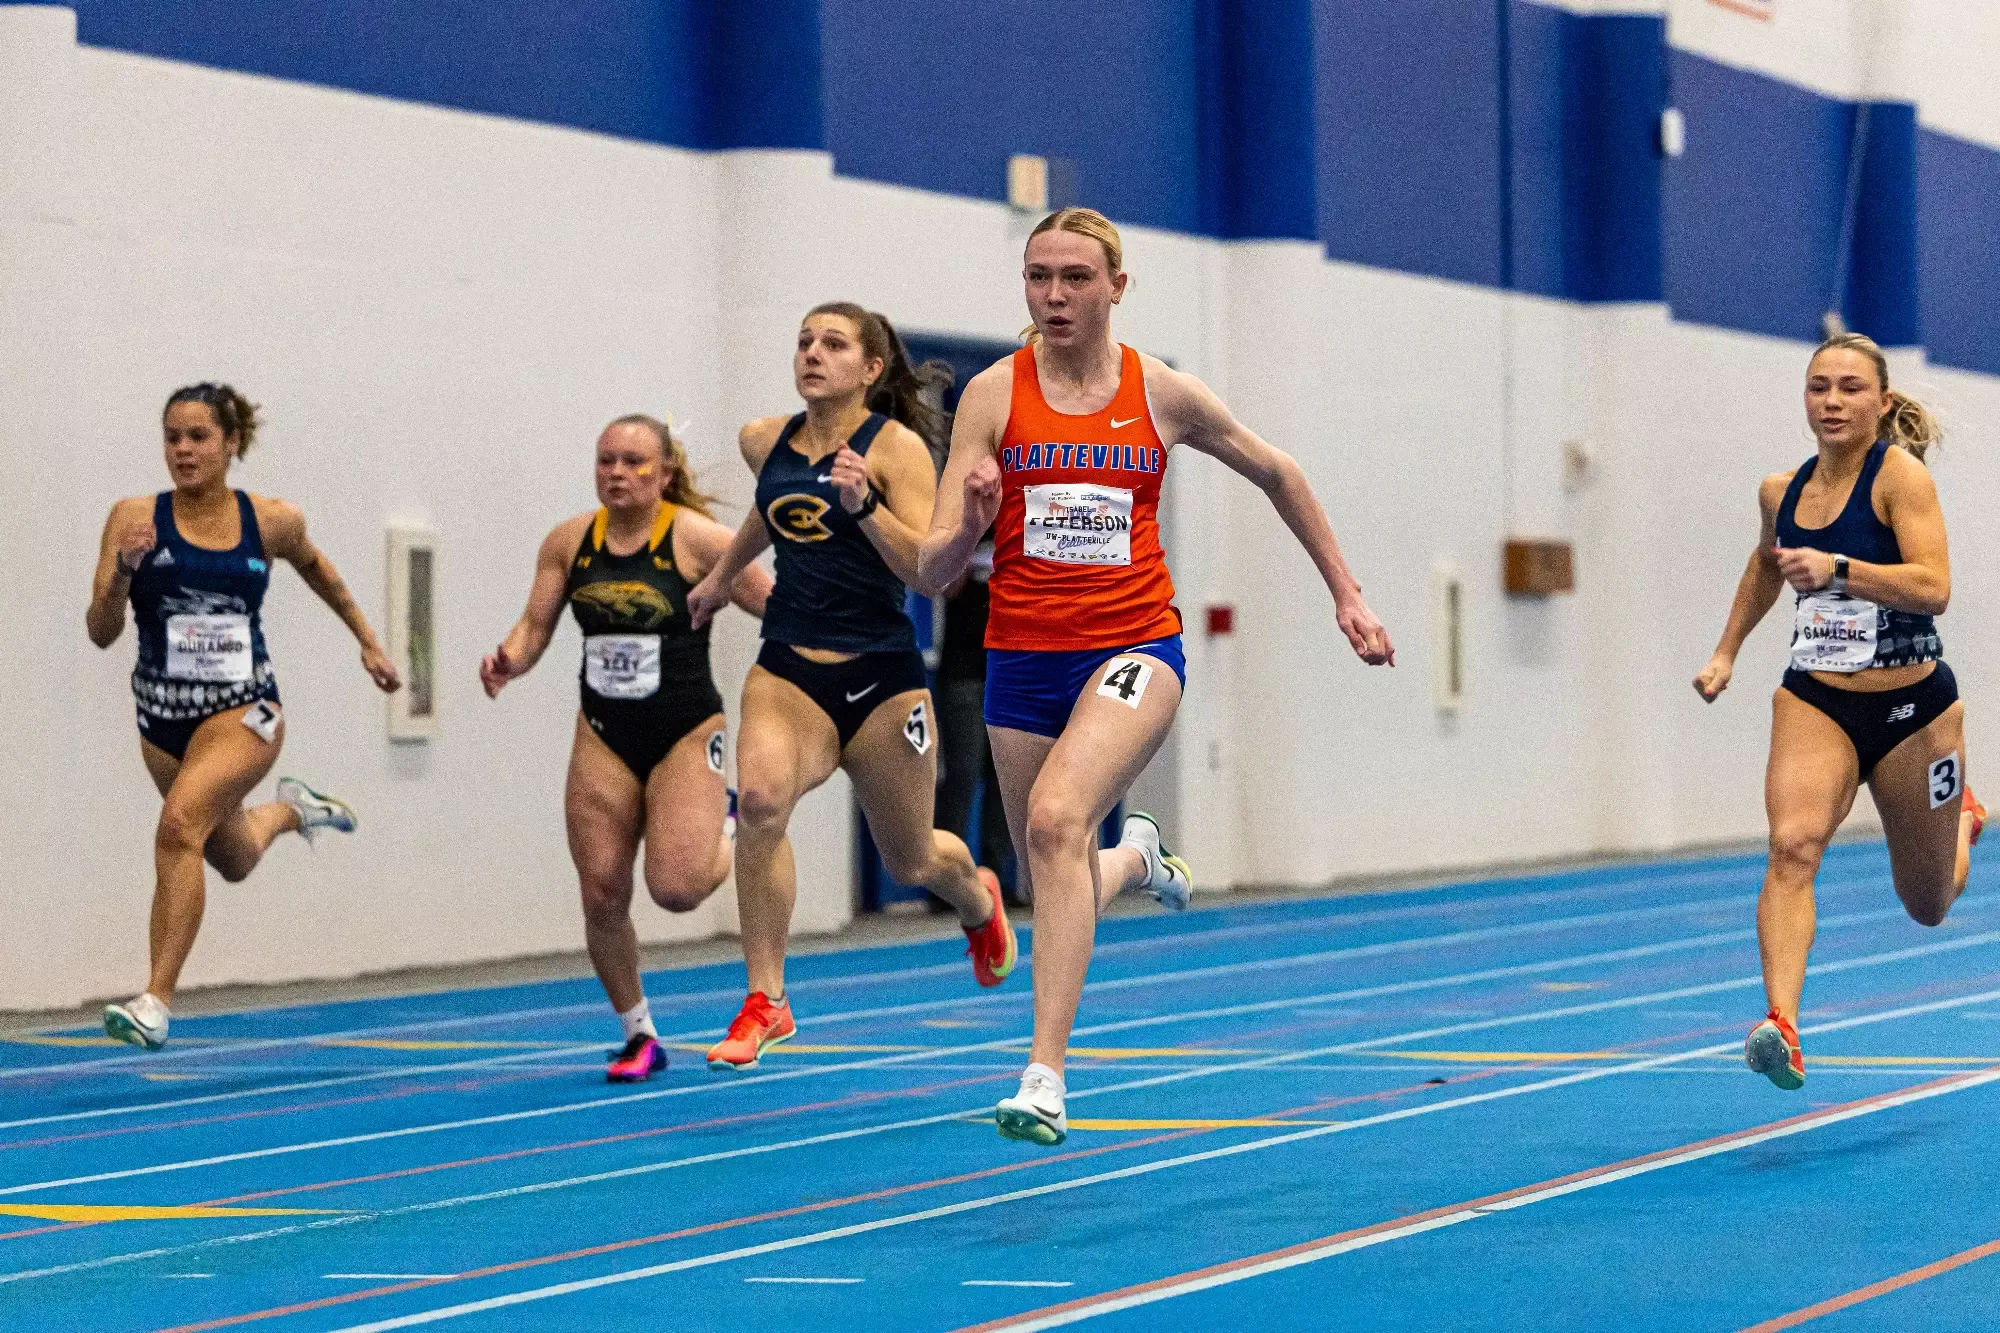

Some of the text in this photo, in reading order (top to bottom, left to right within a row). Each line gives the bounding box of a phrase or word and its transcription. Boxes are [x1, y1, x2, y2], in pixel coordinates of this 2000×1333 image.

[1003, 443, 1159, 473] PLATTEVILLE
[1104, 661, 1142, 700] 4
[907, 706, 925, 748] 5
[709, 734, 723, 770] 6
[1934, 758, 1956, 801] 3
